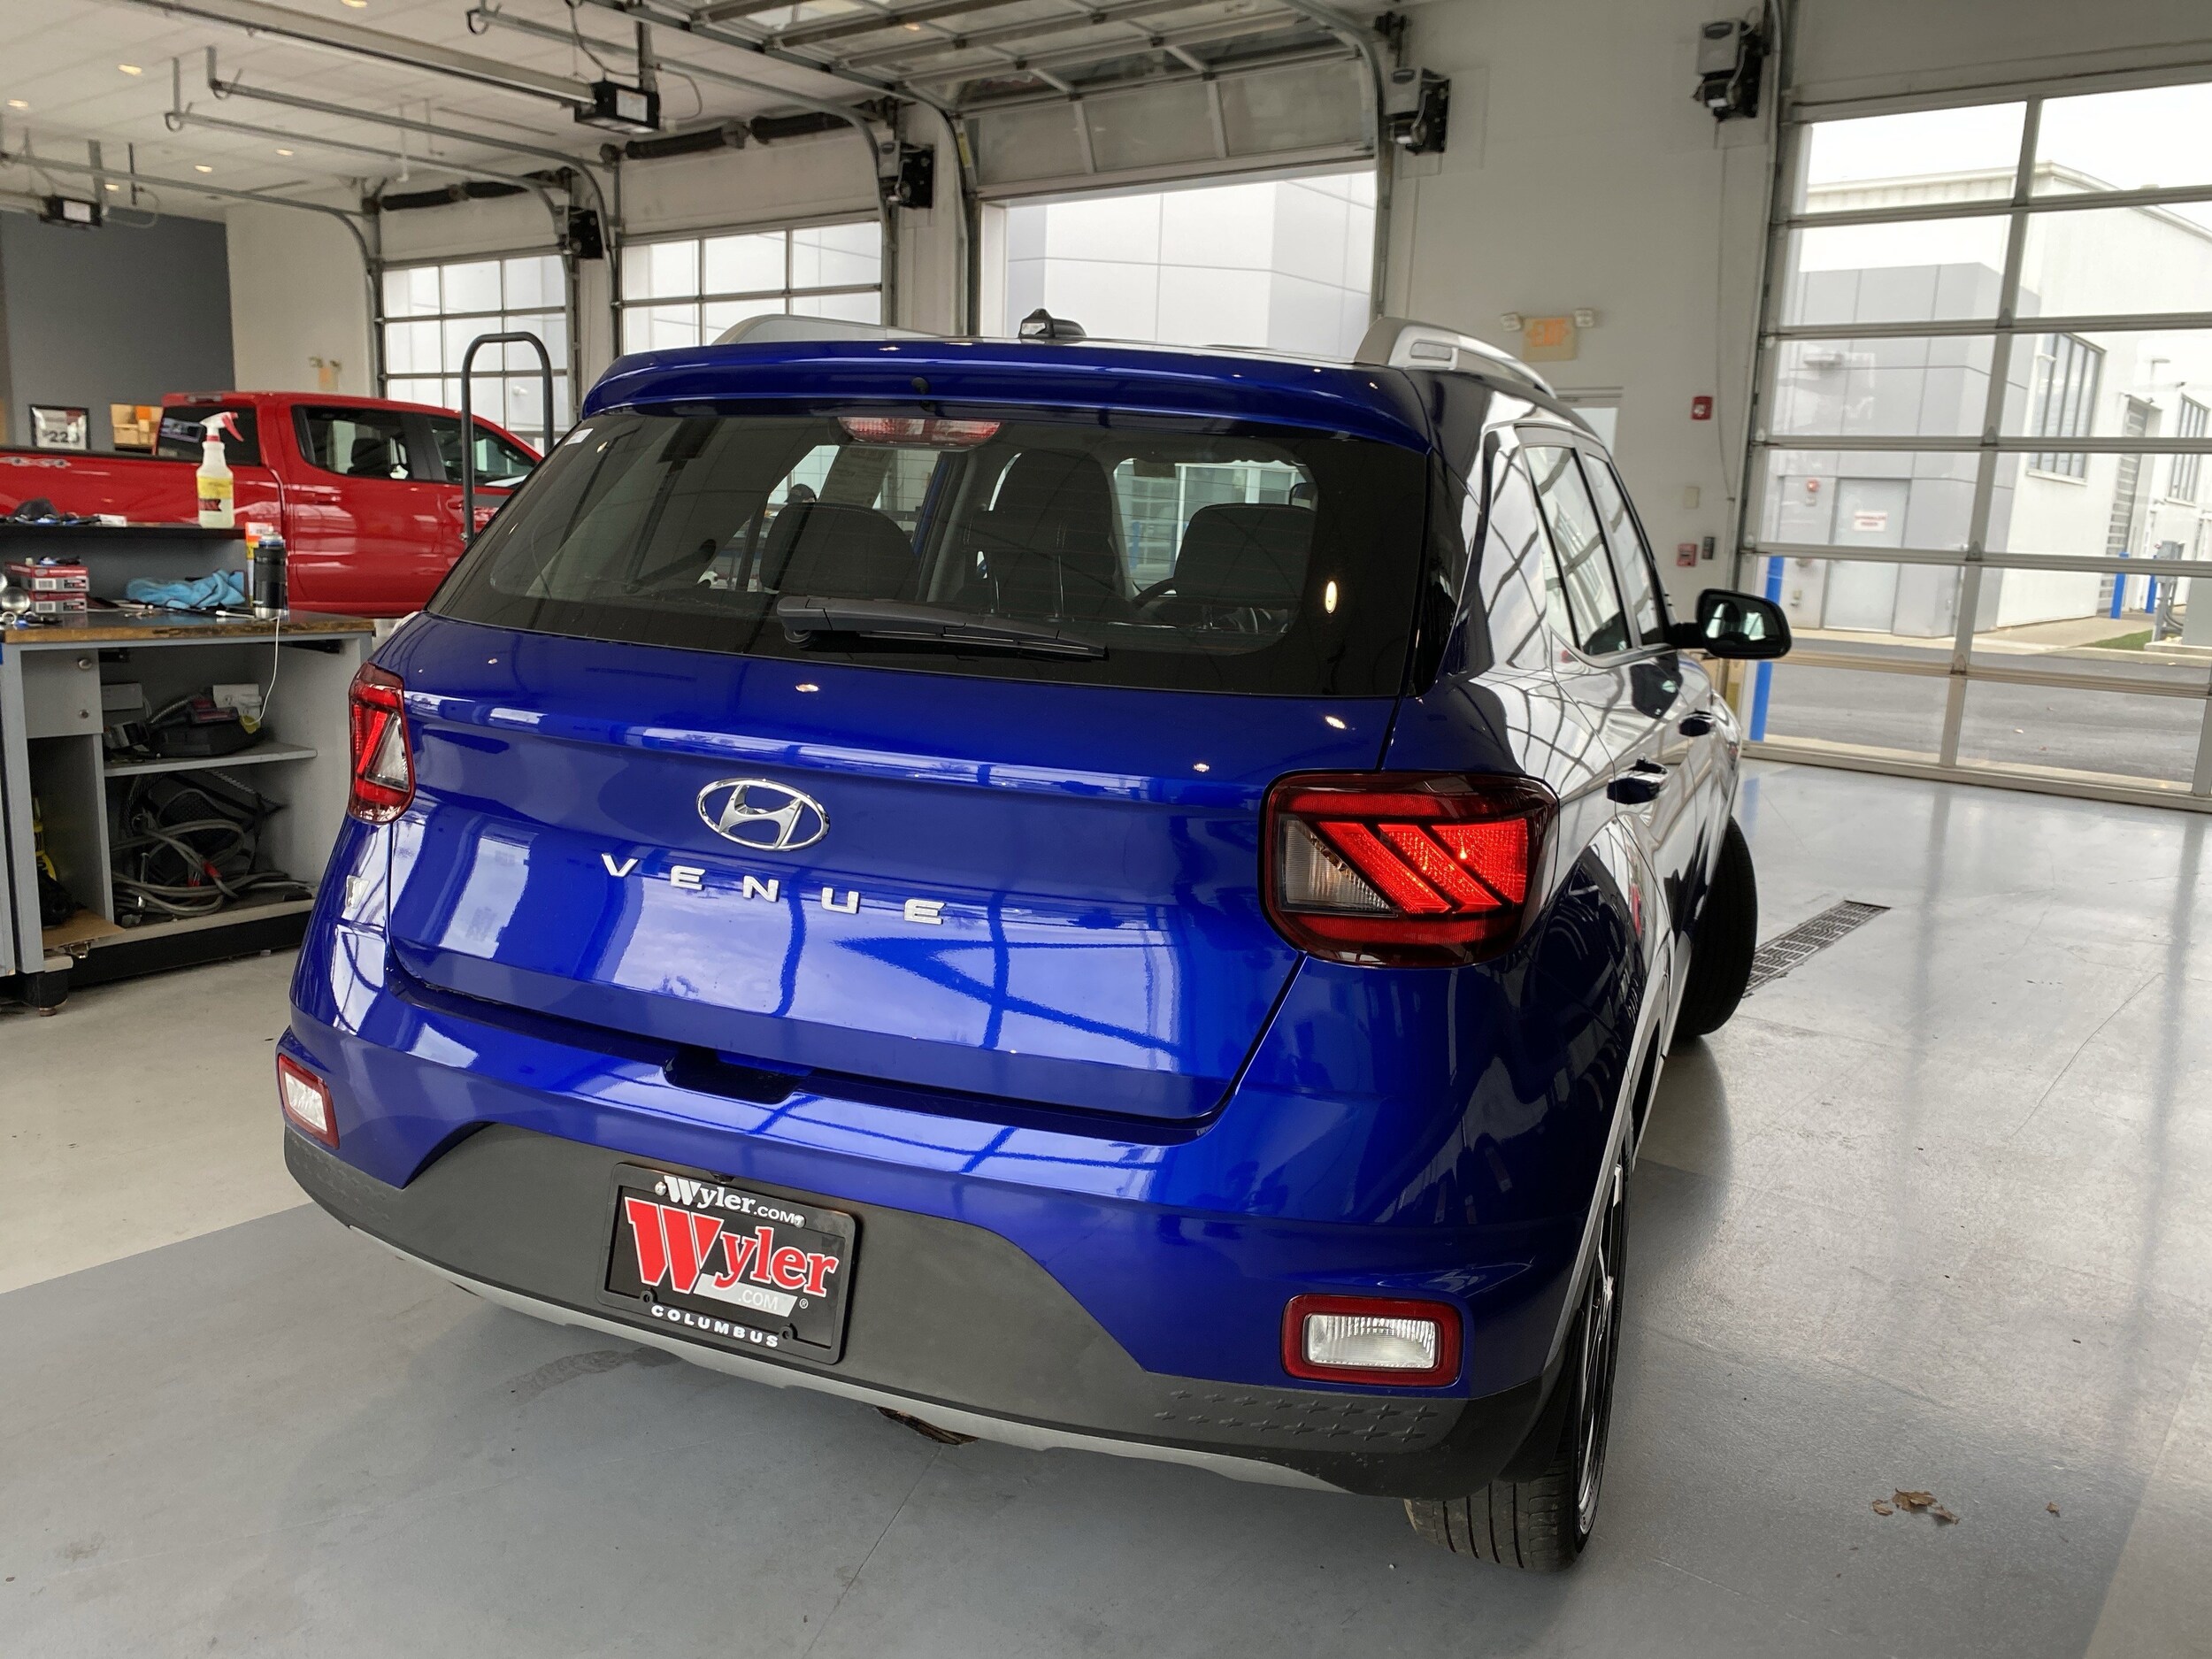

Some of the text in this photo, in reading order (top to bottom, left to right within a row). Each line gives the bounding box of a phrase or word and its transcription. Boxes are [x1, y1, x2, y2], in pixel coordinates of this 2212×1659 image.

[601, 852, 946, 926] VENUE
[624, 1196, 840, 1298] Wyler
[650, 1304, 780, 1348] COLUMBUS
